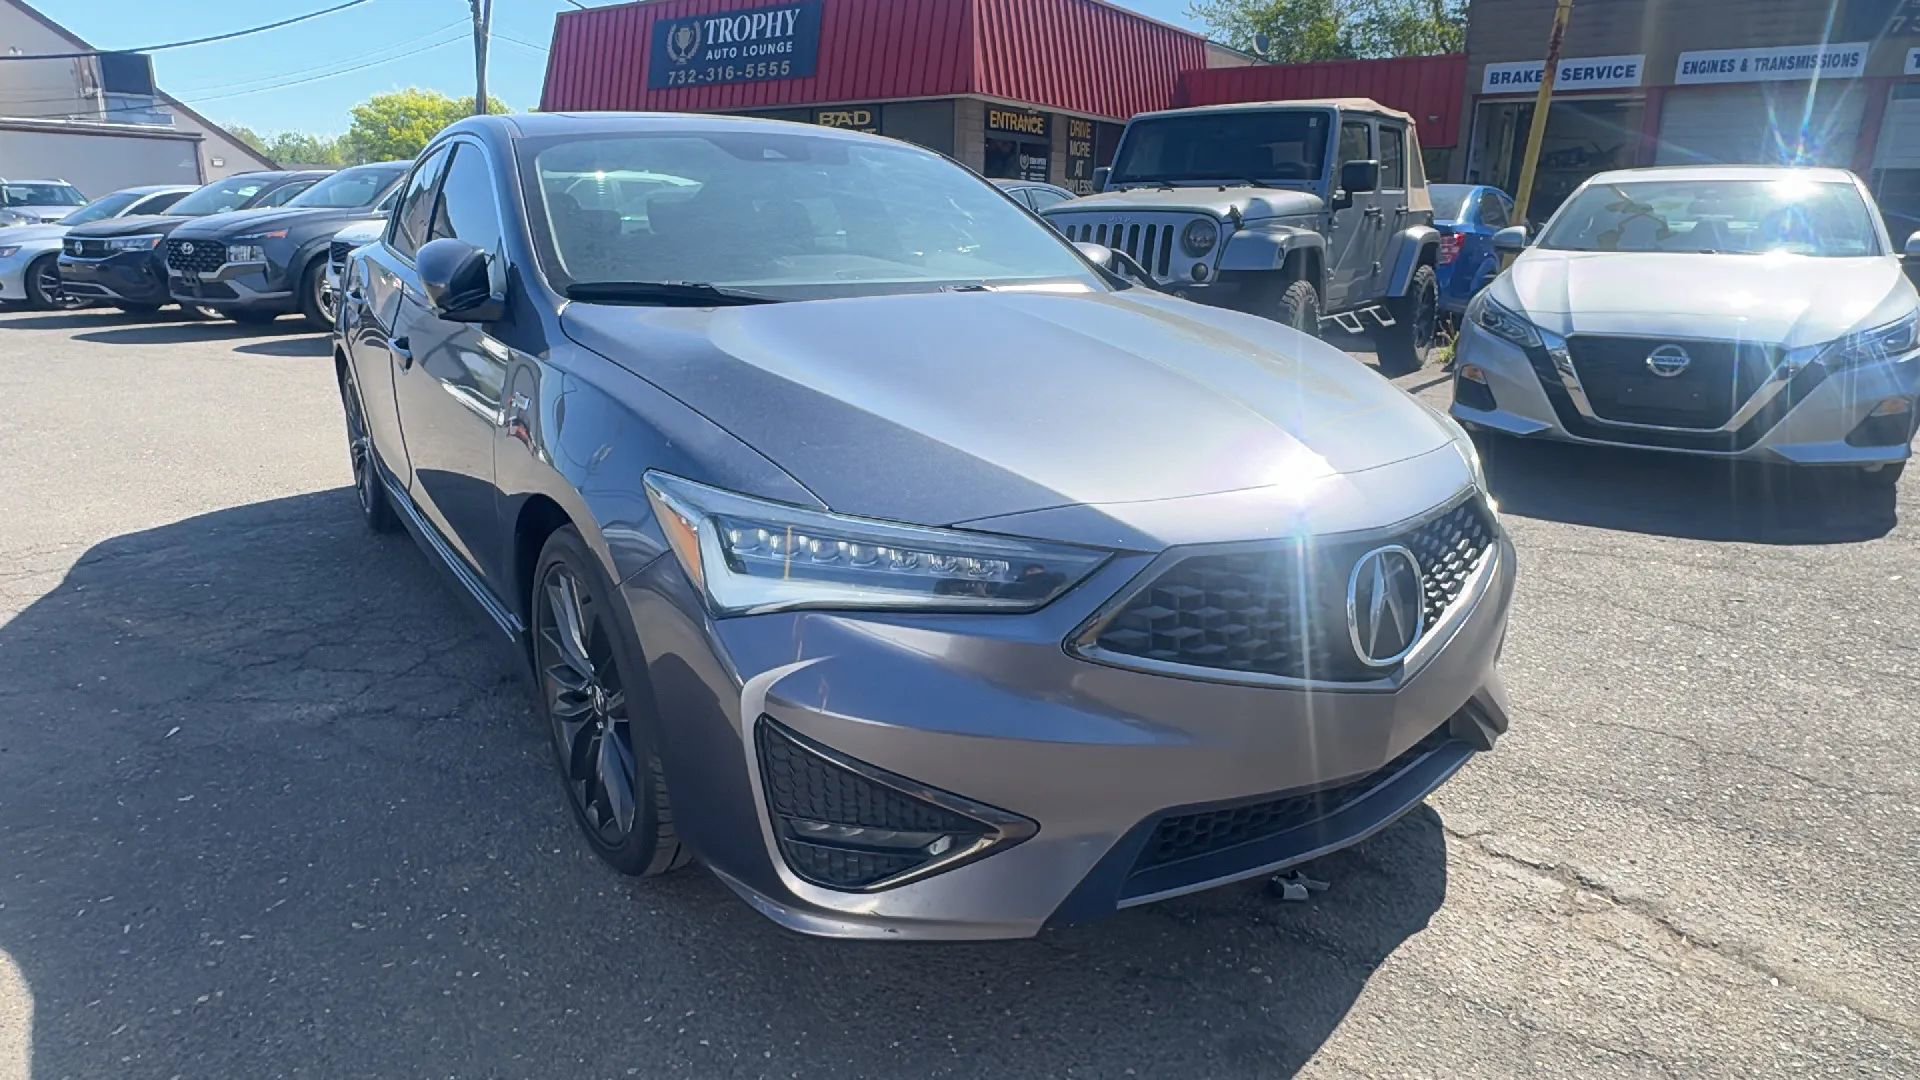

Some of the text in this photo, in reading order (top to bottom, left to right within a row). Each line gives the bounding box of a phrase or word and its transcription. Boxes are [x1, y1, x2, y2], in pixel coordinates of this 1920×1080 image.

[704, 9, 800, 45] TROPHY
[705, 42, 793, 60] AUTO LOUNGE
[668, 60, 790, 85] 732-316-5555
[1682, 52, 1859, 75] ENGINES & TRANSMISSIONS
[1490, 64, 1637, 85] BRAKE SERVICE
[819, 110, 871, 127] BAD
[990, 110, 1044, 135] ENTRANCE
[1070, 120, 1091, 139] DRIVE
[1070, 140, 1090, 157] MORE
[1074, 160, 1085, 176] AT
